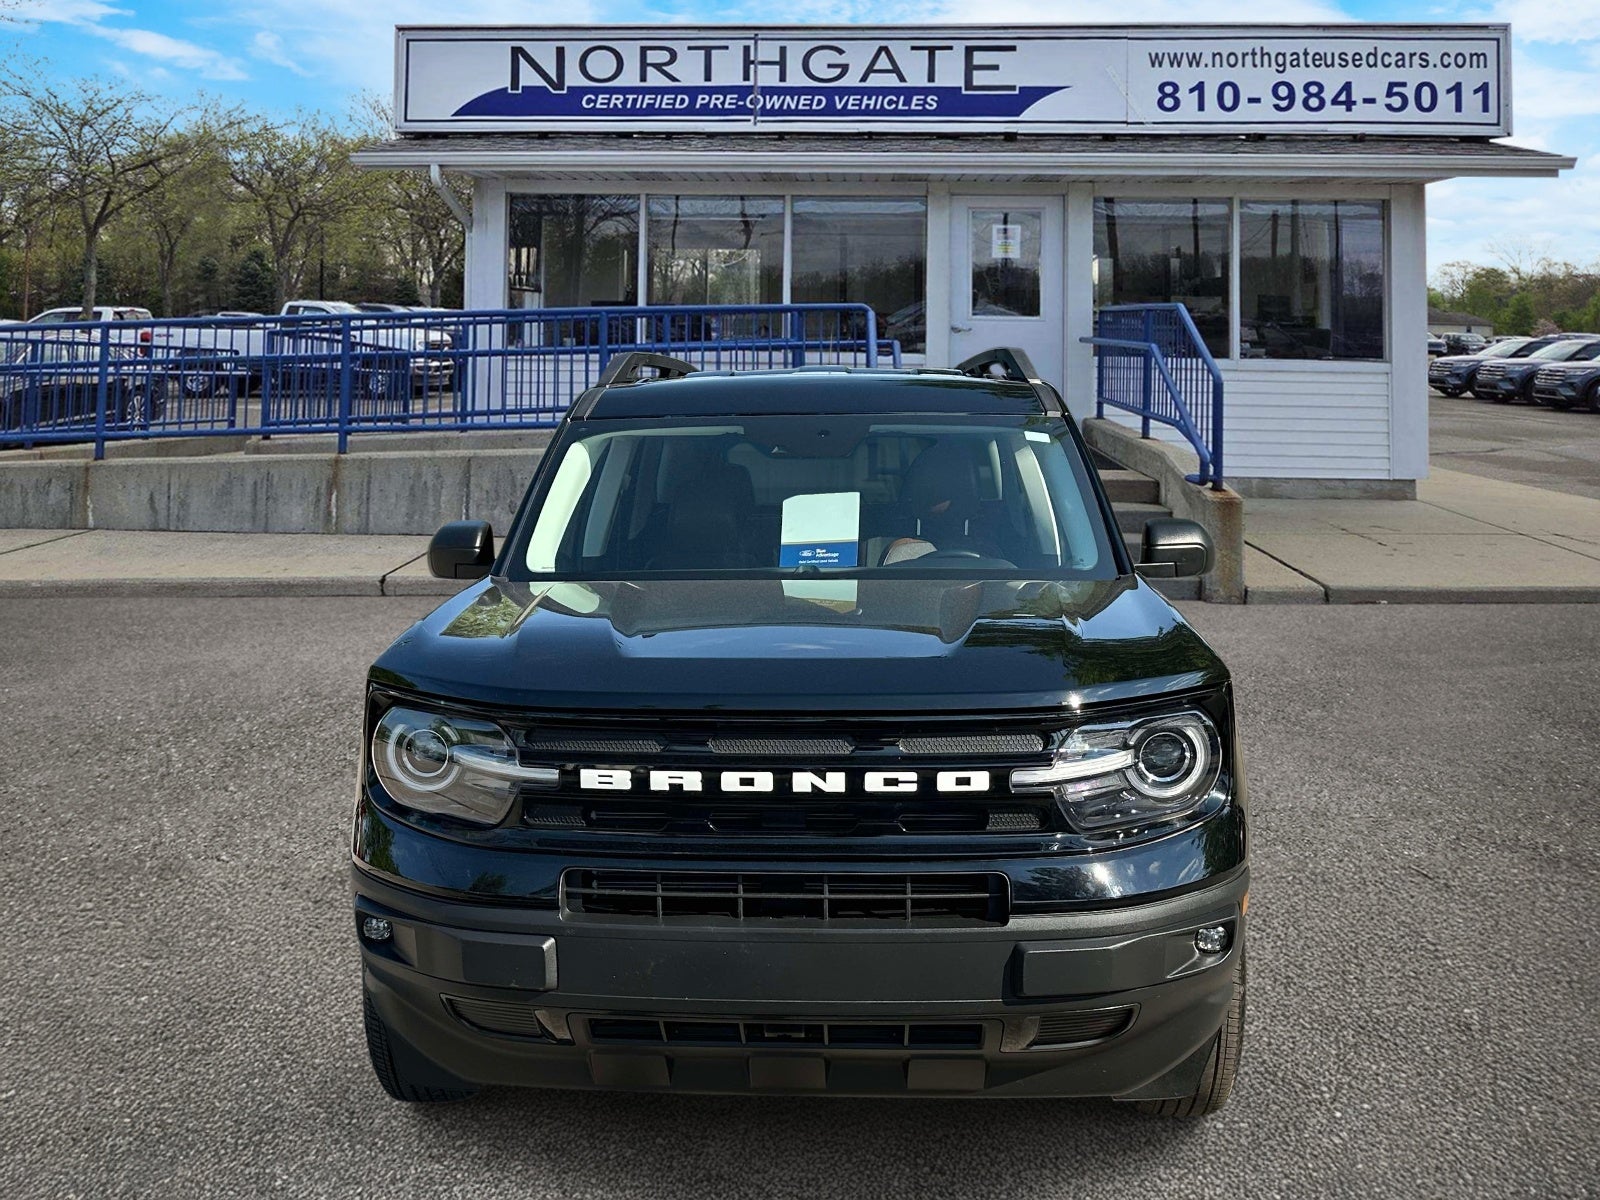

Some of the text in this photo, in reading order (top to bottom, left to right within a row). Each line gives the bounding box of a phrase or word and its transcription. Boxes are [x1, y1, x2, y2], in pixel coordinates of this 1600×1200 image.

[509, 44, 1017, 92] NORTHGATE
[1148, 45, 1489, 74] www.northgateusedcars.com
[581, 94, 939, 111] CERTIFIED PRE-OWNED VEHICLES
[1156, 80, 1490, 113] 810-984-5011
[579, 768, 990, 793] BRONCO
